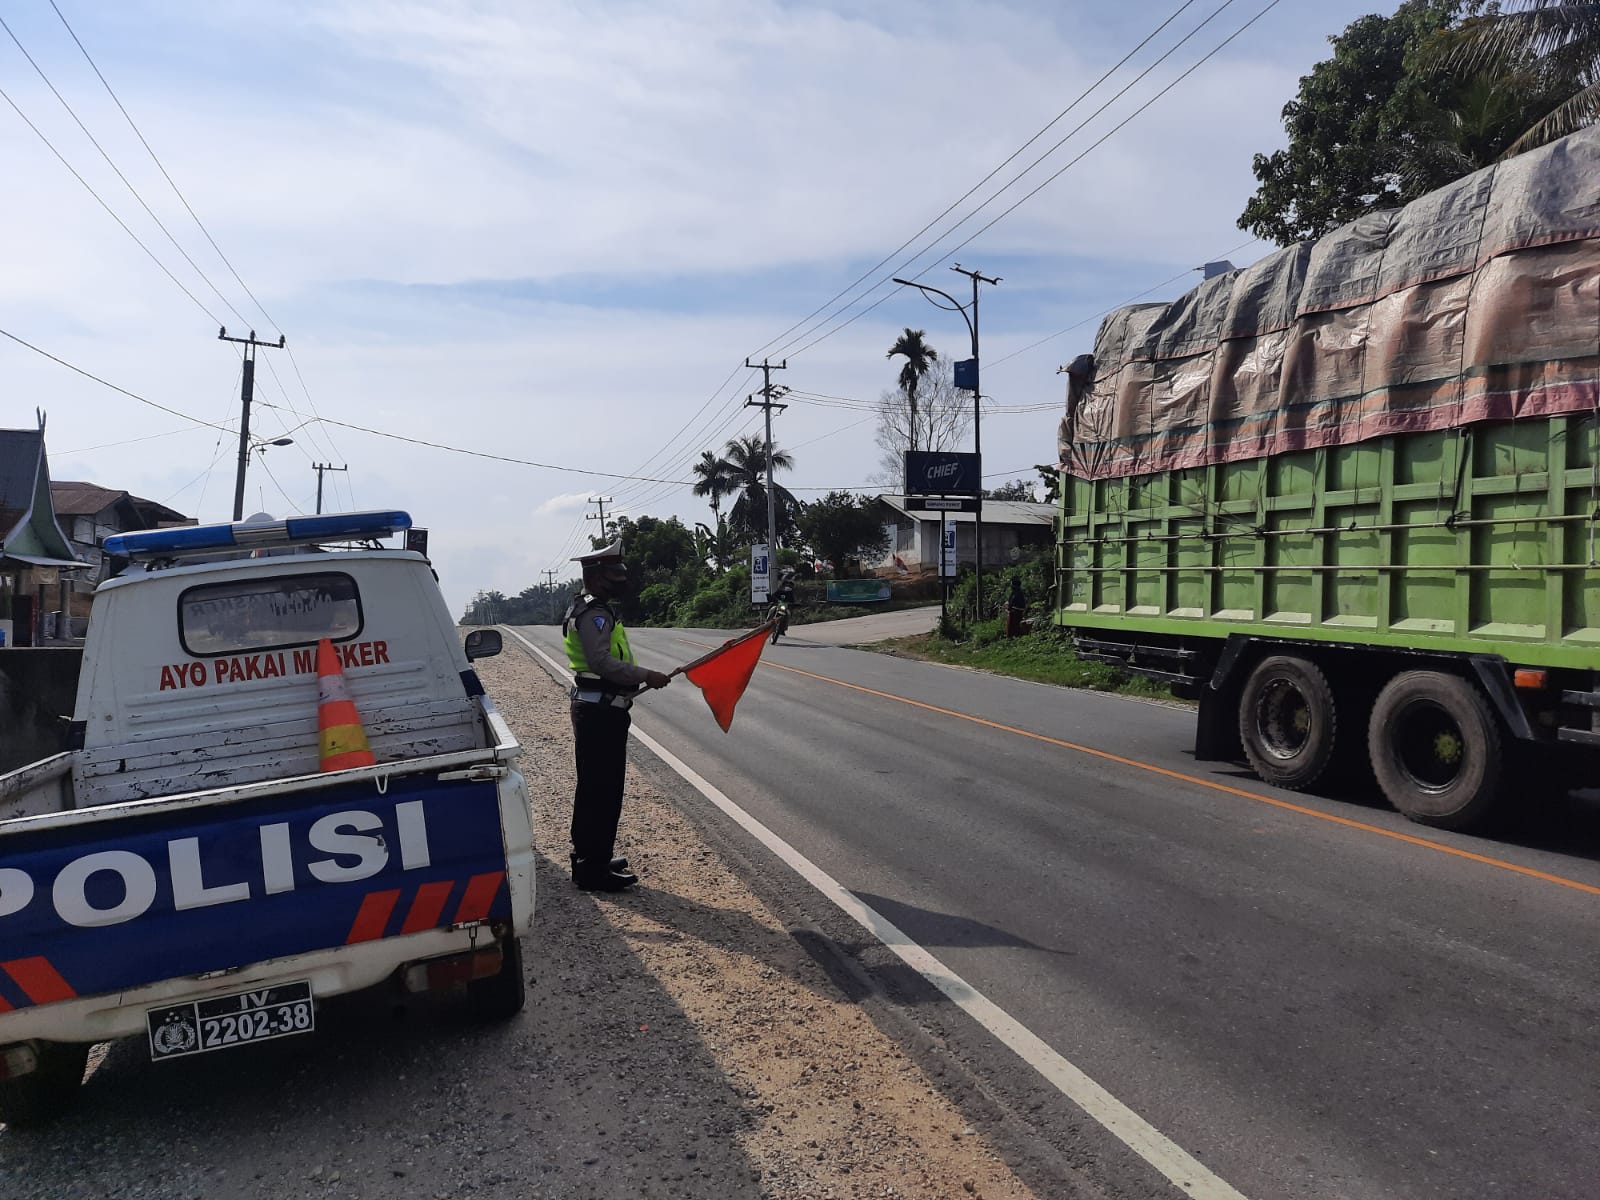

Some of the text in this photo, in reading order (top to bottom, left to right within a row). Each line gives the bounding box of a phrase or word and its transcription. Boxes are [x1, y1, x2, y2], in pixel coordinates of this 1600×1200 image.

[927, 462, 959, 479] CHIEF
[159, 640, 390, 690] AYO PAKAI MKER
[239, 990, 270, 1010] IV
[205, 1003, 310, 1047] 2202-38
